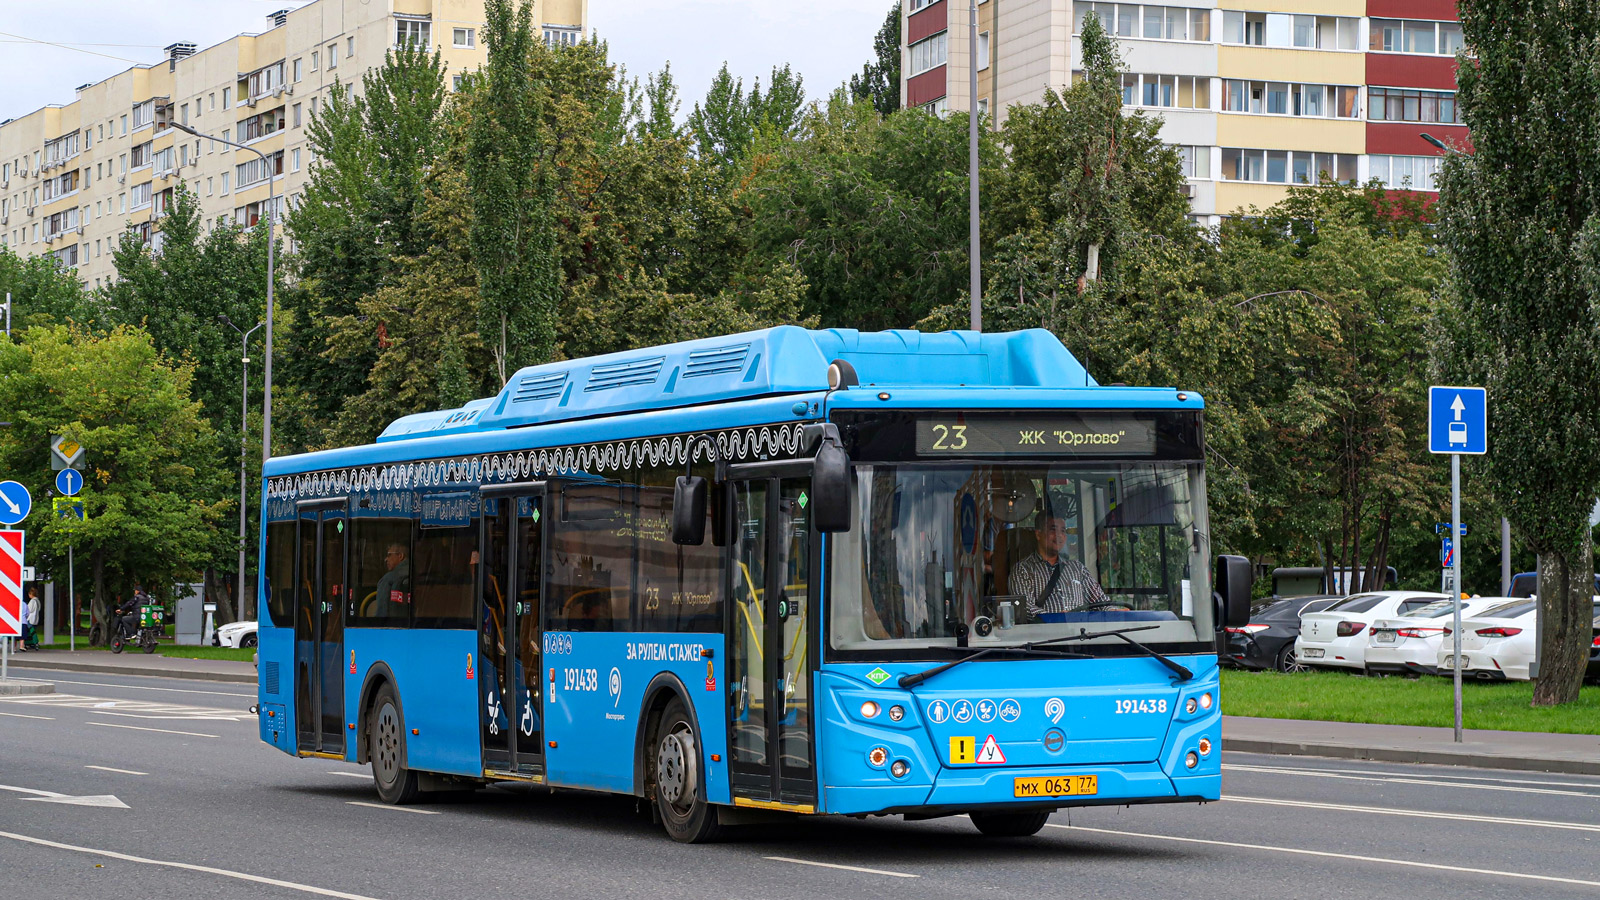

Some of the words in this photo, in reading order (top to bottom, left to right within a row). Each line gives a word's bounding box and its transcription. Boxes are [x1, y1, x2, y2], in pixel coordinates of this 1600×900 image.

[932, 424, 968, 450] 23
[1018, 430, 1046, 445] ЖК
[1053, 430, 1126, 446] "Юрлово"
[646, 587, 660, 610] 23
[671, 592, 683, 605] ЖК
[626, 642, 638, 660] ЗА
[638, 643, 667, 661] РУЛЕМ
[668, 643, 704, 662] СТАЖЕР
[564, 668, 598, 692] 191438
[1115, 699, 1167, 714] 191438
[1021, 783, 1039, 794] МХ
[1045, 778, 1071, 793] 063
[1079, 777, 1093, 788] 77
